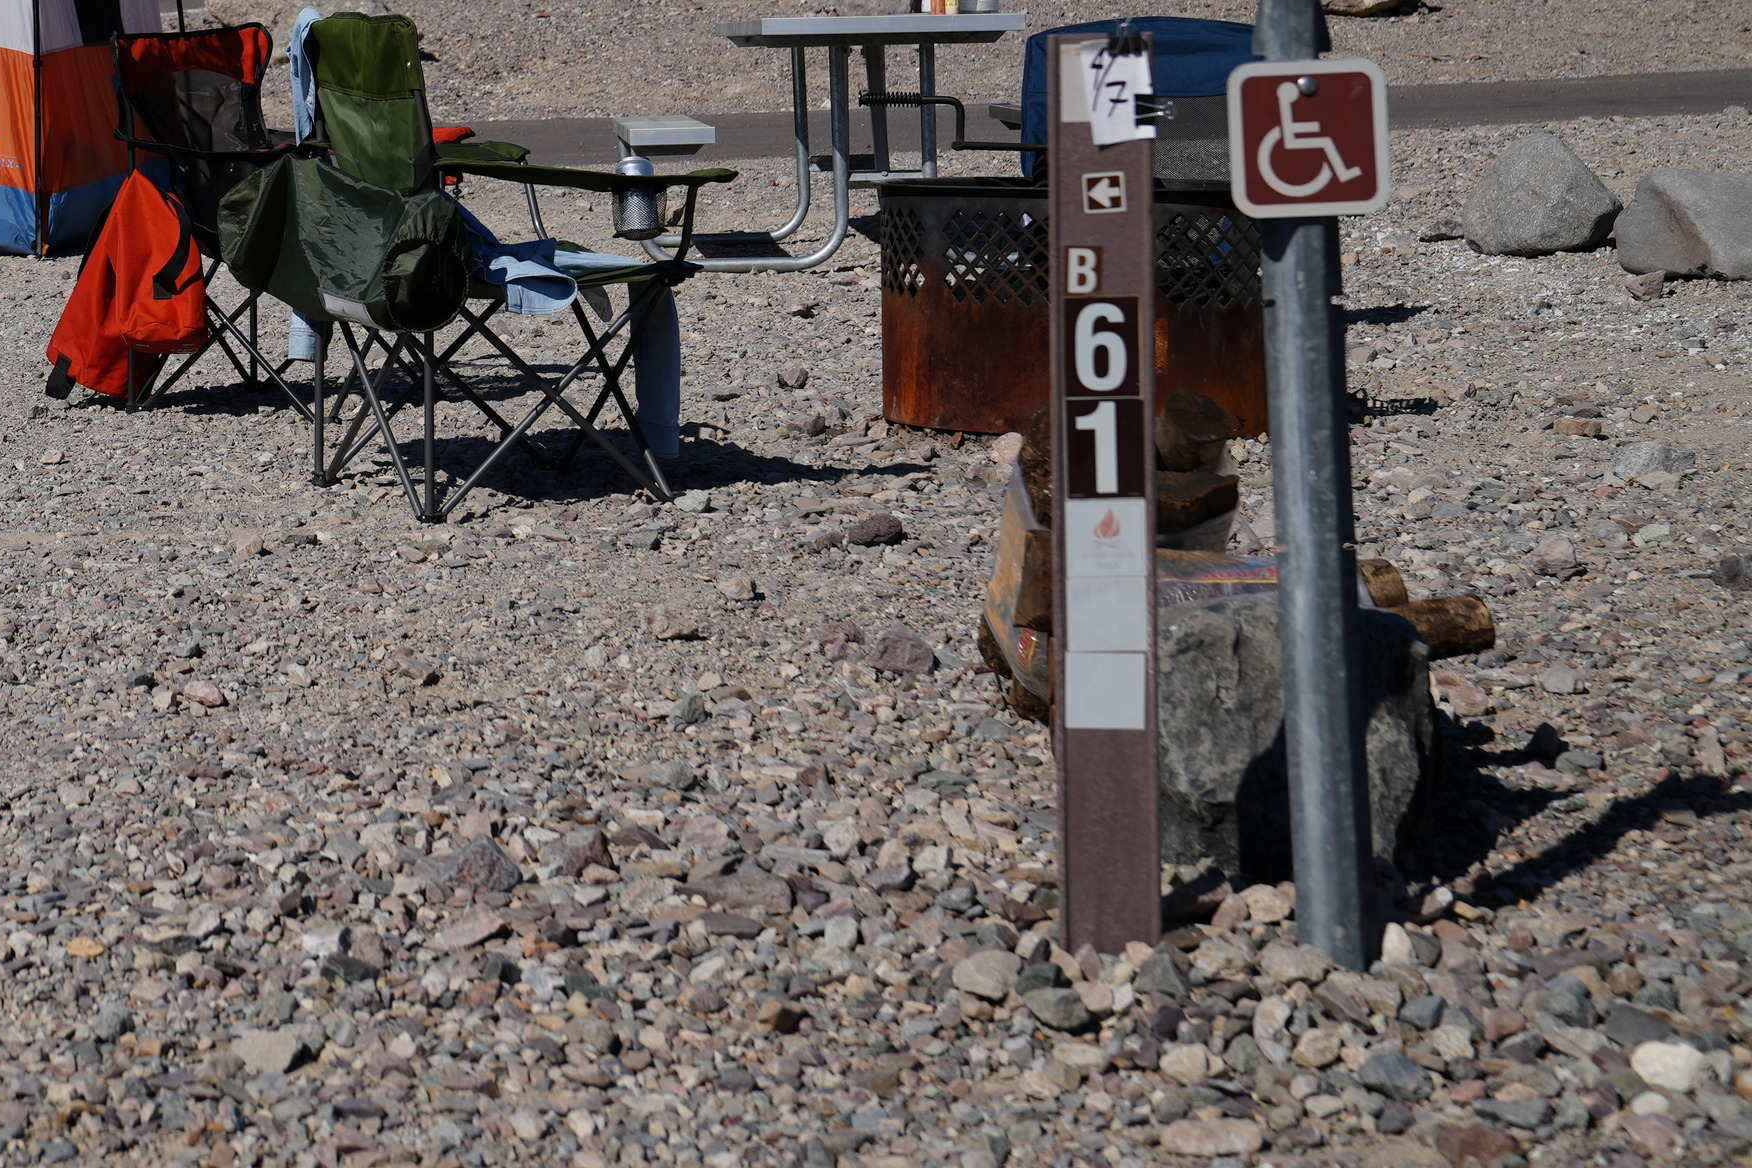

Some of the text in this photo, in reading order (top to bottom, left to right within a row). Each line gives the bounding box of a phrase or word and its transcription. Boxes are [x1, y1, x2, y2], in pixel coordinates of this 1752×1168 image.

[1, 158, 14, 169] LX
[1066, 247, 1098, 295] B
[1074, 301, 1128, 392] 6
[1074, 400, 1120, 494] 1
